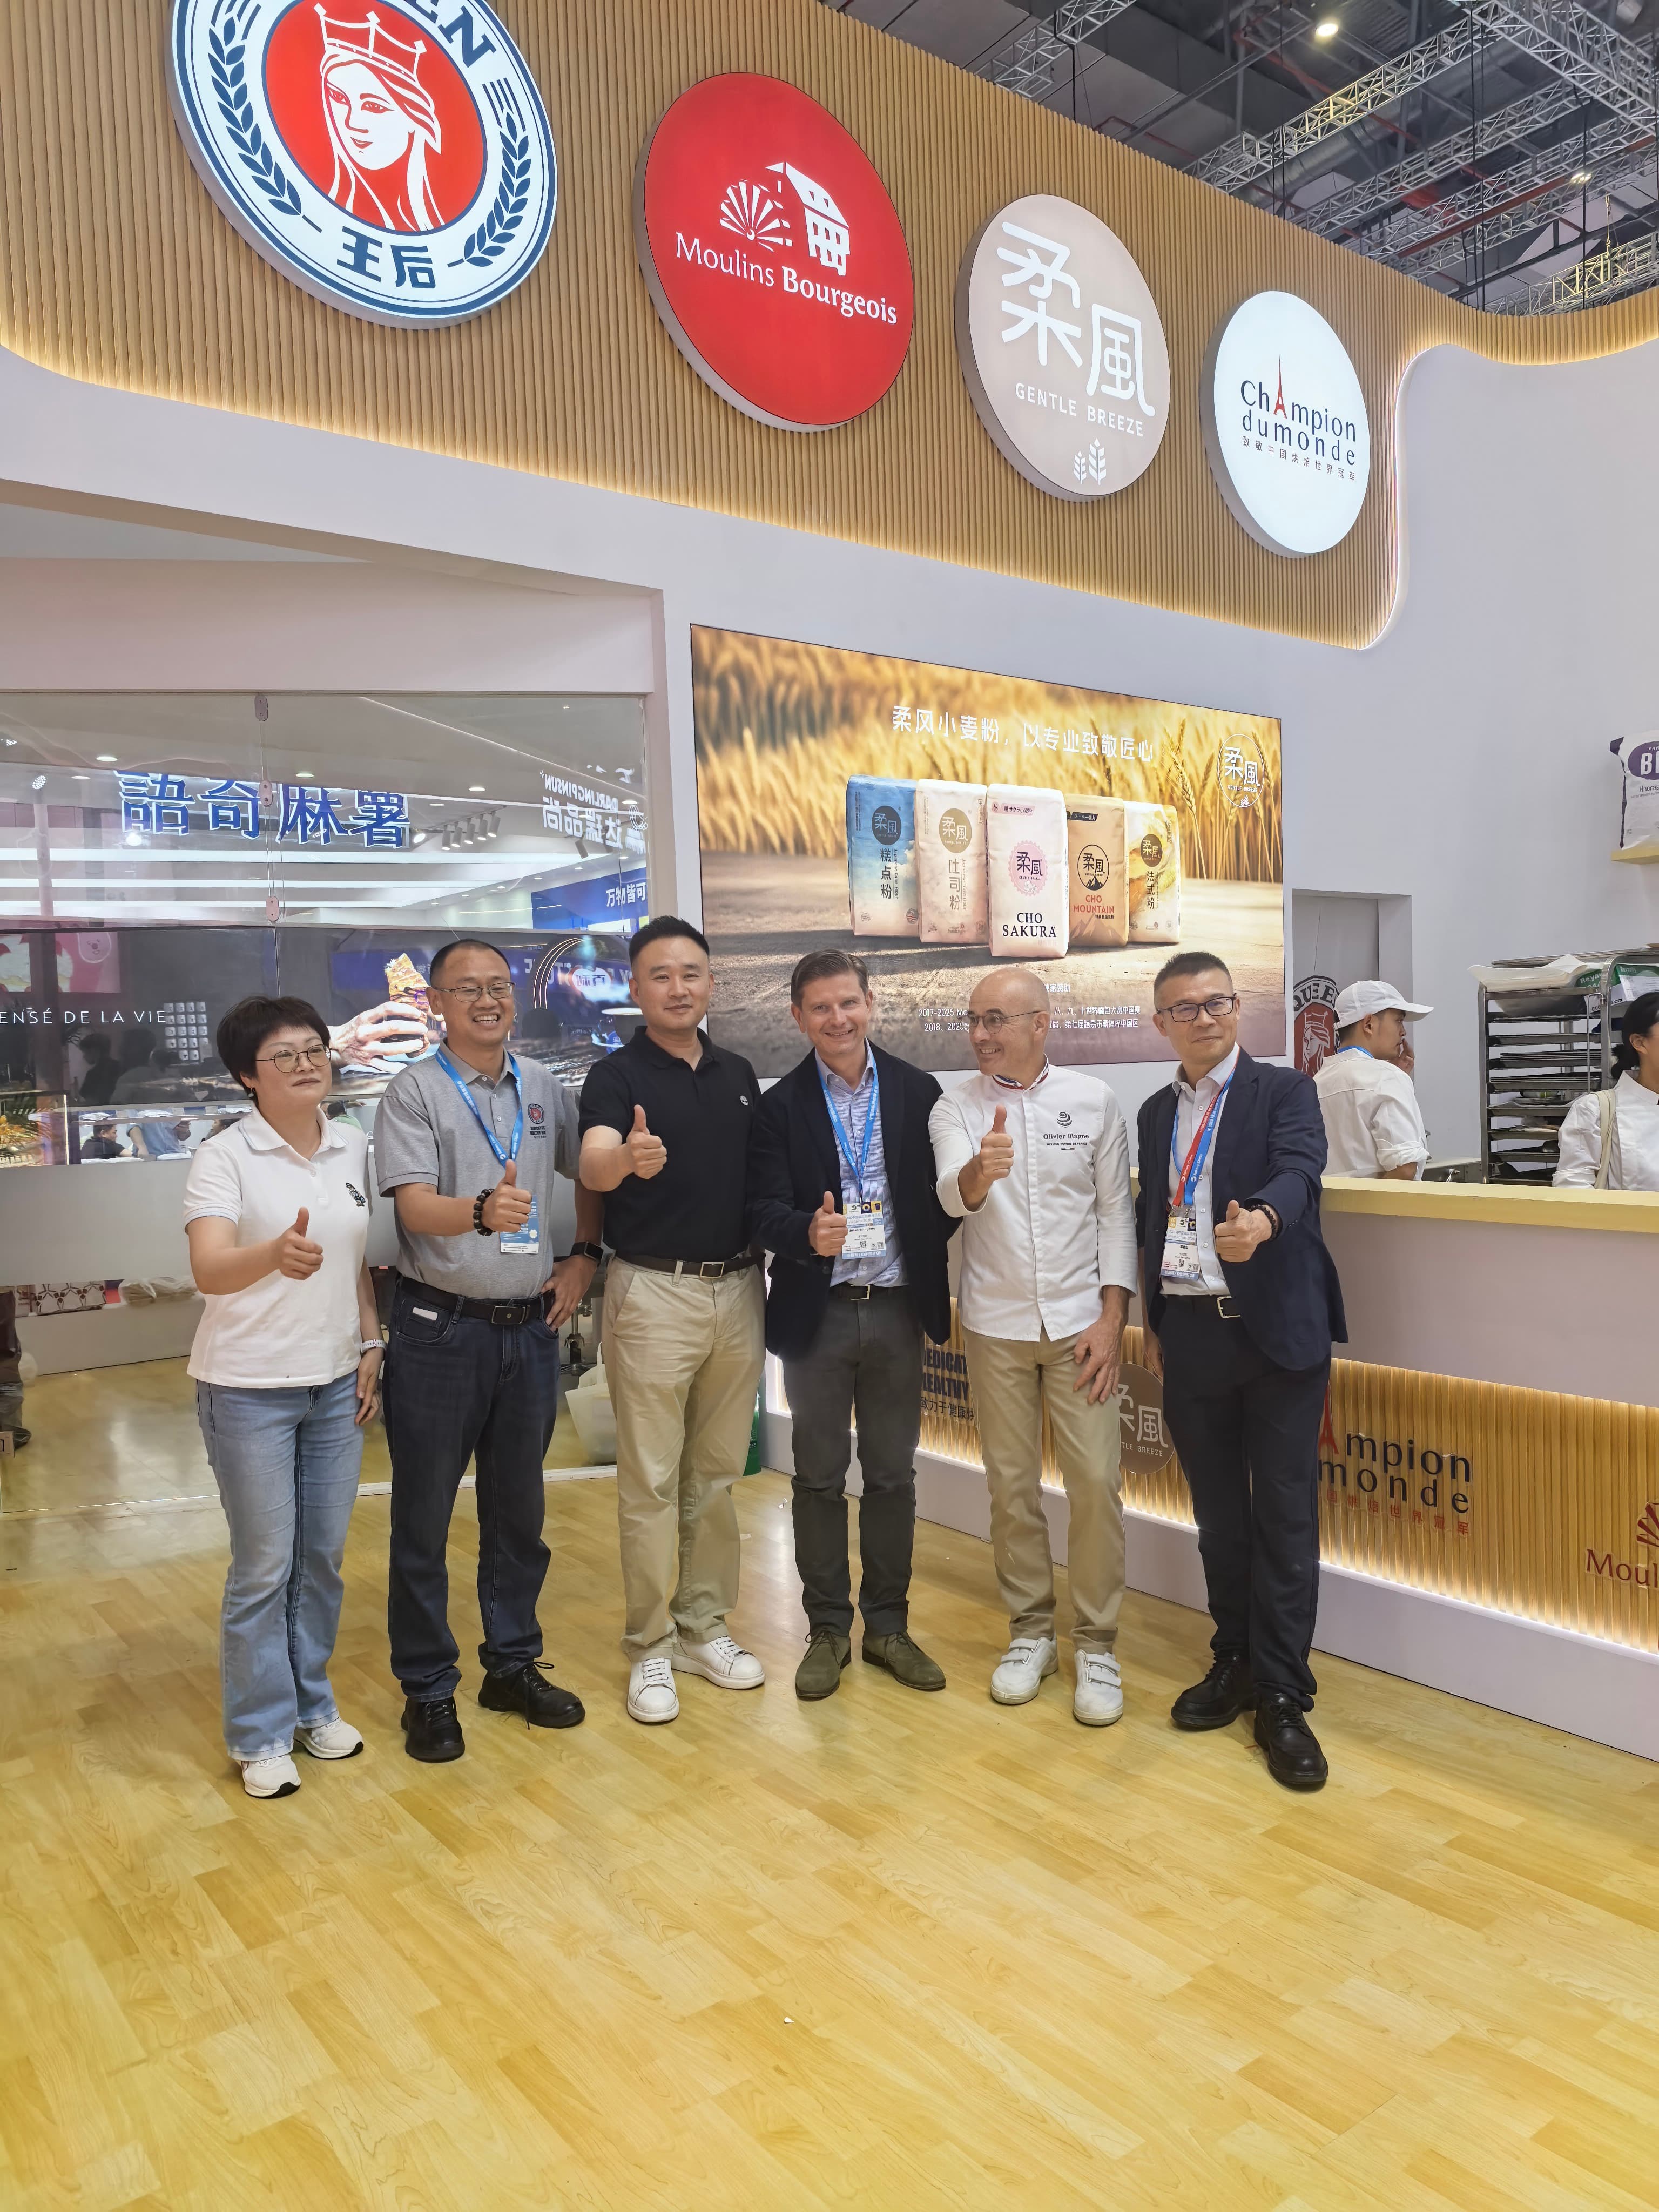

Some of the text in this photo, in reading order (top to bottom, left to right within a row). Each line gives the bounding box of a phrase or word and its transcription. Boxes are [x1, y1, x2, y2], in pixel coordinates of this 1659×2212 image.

[337, 226, 436, 289] 王后
[676, 232, 898, 325] Moulins Bourgeois
[997, 221, 1156, 416] 柔風
[1015, 382, 1143, 437] GENTLE BREEZE
[1243, 436, 1355, 482] 致敬中国烘焙世界冠军
[1224, 746, 1261, 787] 柔風
[1641, 751, 1659, 775] B
[874, 813, 899, 834] 柔風
[942, 817, 968, 841] 柔風
[1142, 840, 1161, 858] 柔風
[880, 847, 892, 899] 糕点粉
[1016, 851, 1043, 876] 柔風
[1083, 853, 1105, 874] 柔風
[606, 882, 646, 908] 万物皆可
[949, 858, 960, 910] 吐司粉
[1147, 871, 1155, 909] 法式粉
[1074, 904, 1114, 914] MOUNTAIN
[1085, 894, 1102, 903] CHO
[1016, 913, 1043, 923] CHO
[1002, 925, 1057, 938] SAKURA
[1293, 983, 1336, 1012] QUEE
[64, 1011, 90, 1024] DE
[101, 1011, 125, 1023] LA
[133, 1010, 166, 1023] VIE
[918, 1008, 954, 1017] 2017-2025
[956, 1008, 969, 1016] Mo
[924, 1348, 967, 1375] EDICAT
[1137, 1445, 1163, 1457] BREEZE
[1327, 1489, 1469, 1535] 国烘焙世界冠军
[1586, 1548, 1658, 1588] Moul
